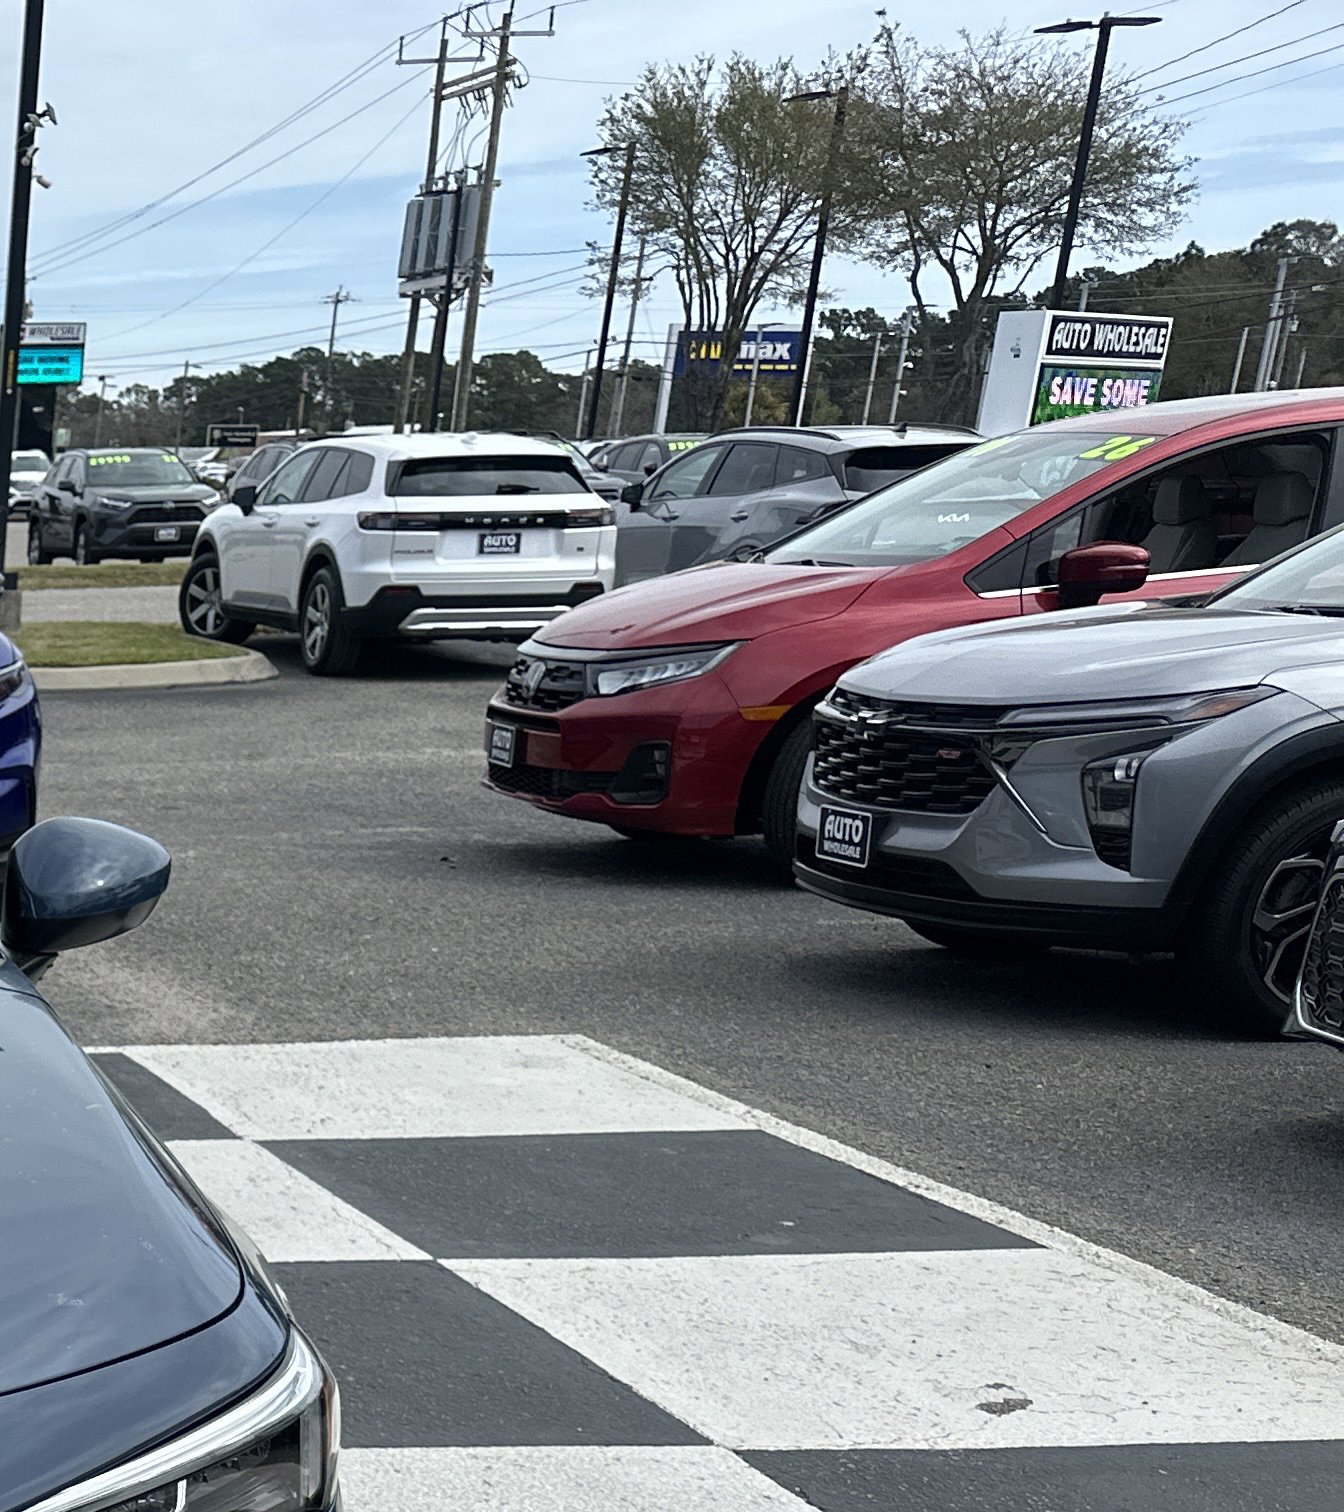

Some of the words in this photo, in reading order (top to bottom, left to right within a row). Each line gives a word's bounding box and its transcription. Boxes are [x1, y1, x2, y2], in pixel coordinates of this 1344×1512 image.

[1052, 322, 1091, 351] AUTO
[1093, 323, 1168, 356] WHOLESALE
[1049, 376, 1098, 406] SAVE
[1100, 378, 1151, 408] SOME
[1079, 435, 1157, 462] 26
[483, 535, 517, 547] AUTO
[824, 815, 864, 844] AUTO
[823, 840, 861, 859] WHOLESALE
